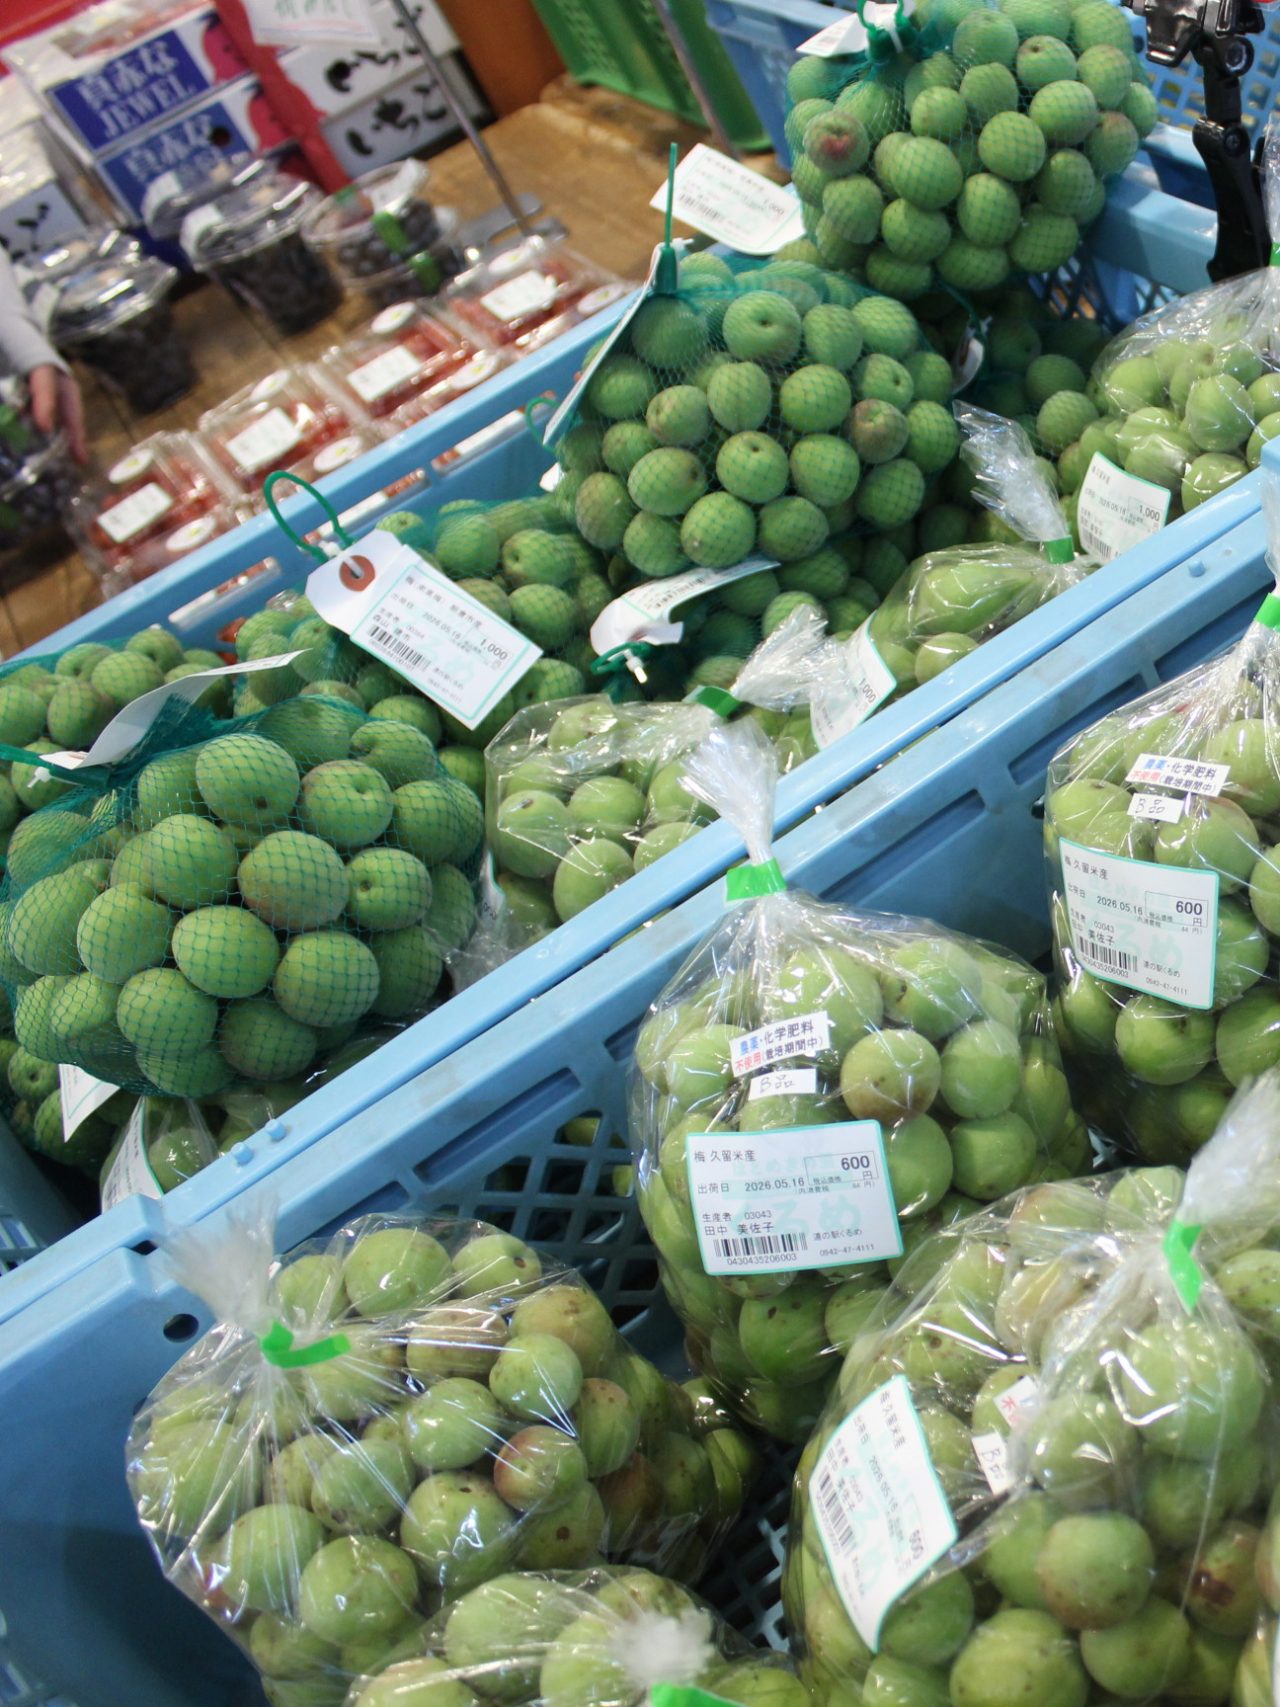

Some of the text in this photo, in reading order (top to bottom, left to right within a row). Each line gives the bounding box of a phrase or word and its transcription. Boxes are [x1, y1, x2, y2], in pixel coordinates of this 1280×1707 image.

[100, 75, 200, 139] JEWEL
[479, 638, 508, 661] 1,000
[1097, 895, 1142, 916] 2026.05.16
[1176, 901, 1202, 916] 600
[694, 1150, 756, 1162] 梅 久留米産
[841, 1155, 870, 1171] 600
[698, 1178, 805, 1194] 出荷日 2026.05.16
[702, 1213, 732, 1223] 生産者
[705, 1222, 774, 1236] 田中 美佐子
